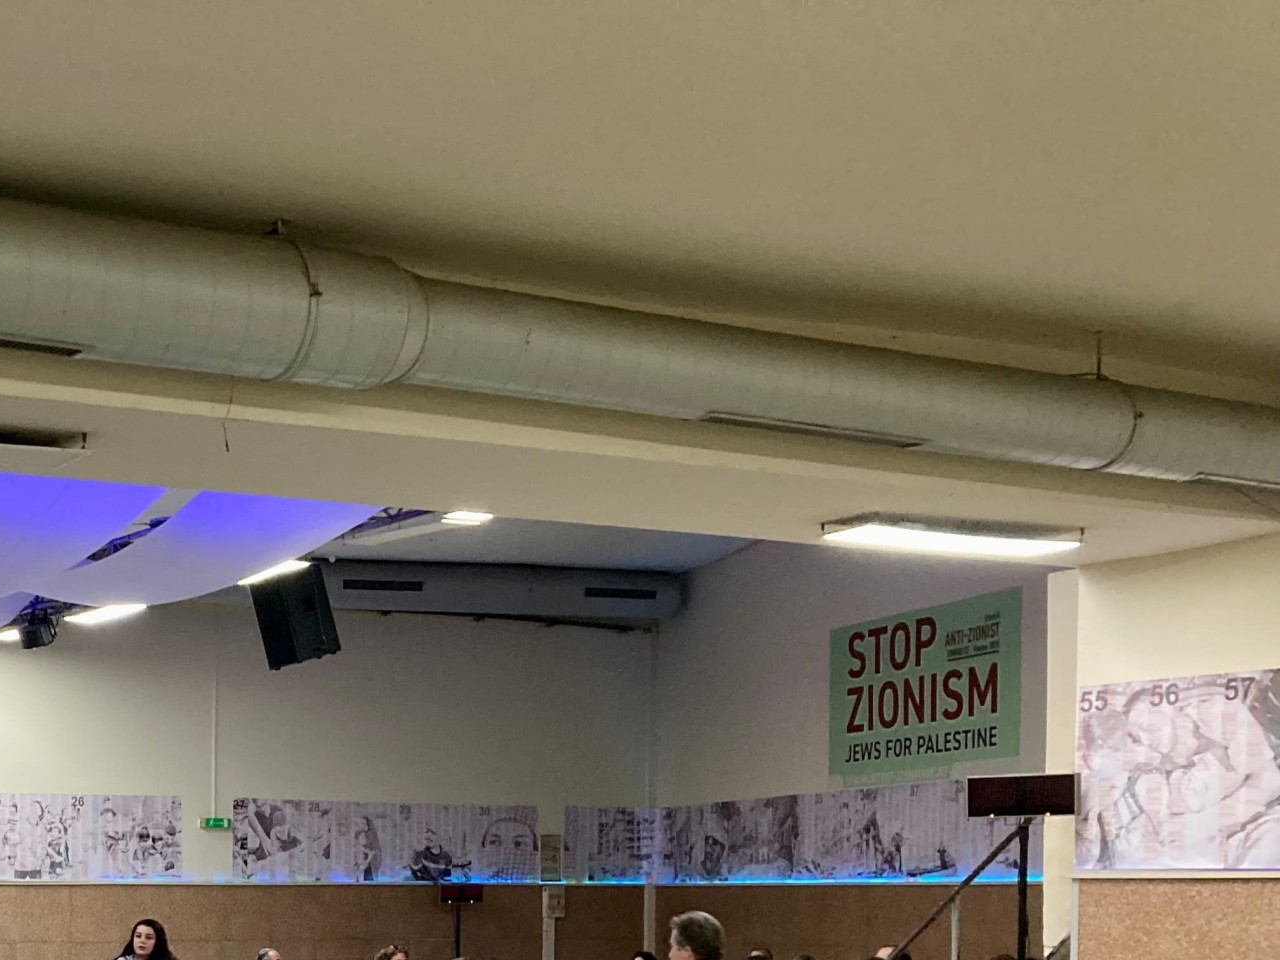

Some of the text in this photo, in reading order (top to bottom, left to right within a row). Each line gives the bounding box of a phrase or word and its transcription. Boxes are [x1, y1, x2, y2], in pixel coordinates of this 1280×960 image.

[847, 616, 937, 679] STOP
[846, 661, 999, 734] ZIONISM
[1080, 677, 1255, 712] 55 56 57
[845, 726, 998, 763] JEWS FOR PALESTINE
[71, 796, 85, 807] 26
[308, 802, 320, 812] 28
